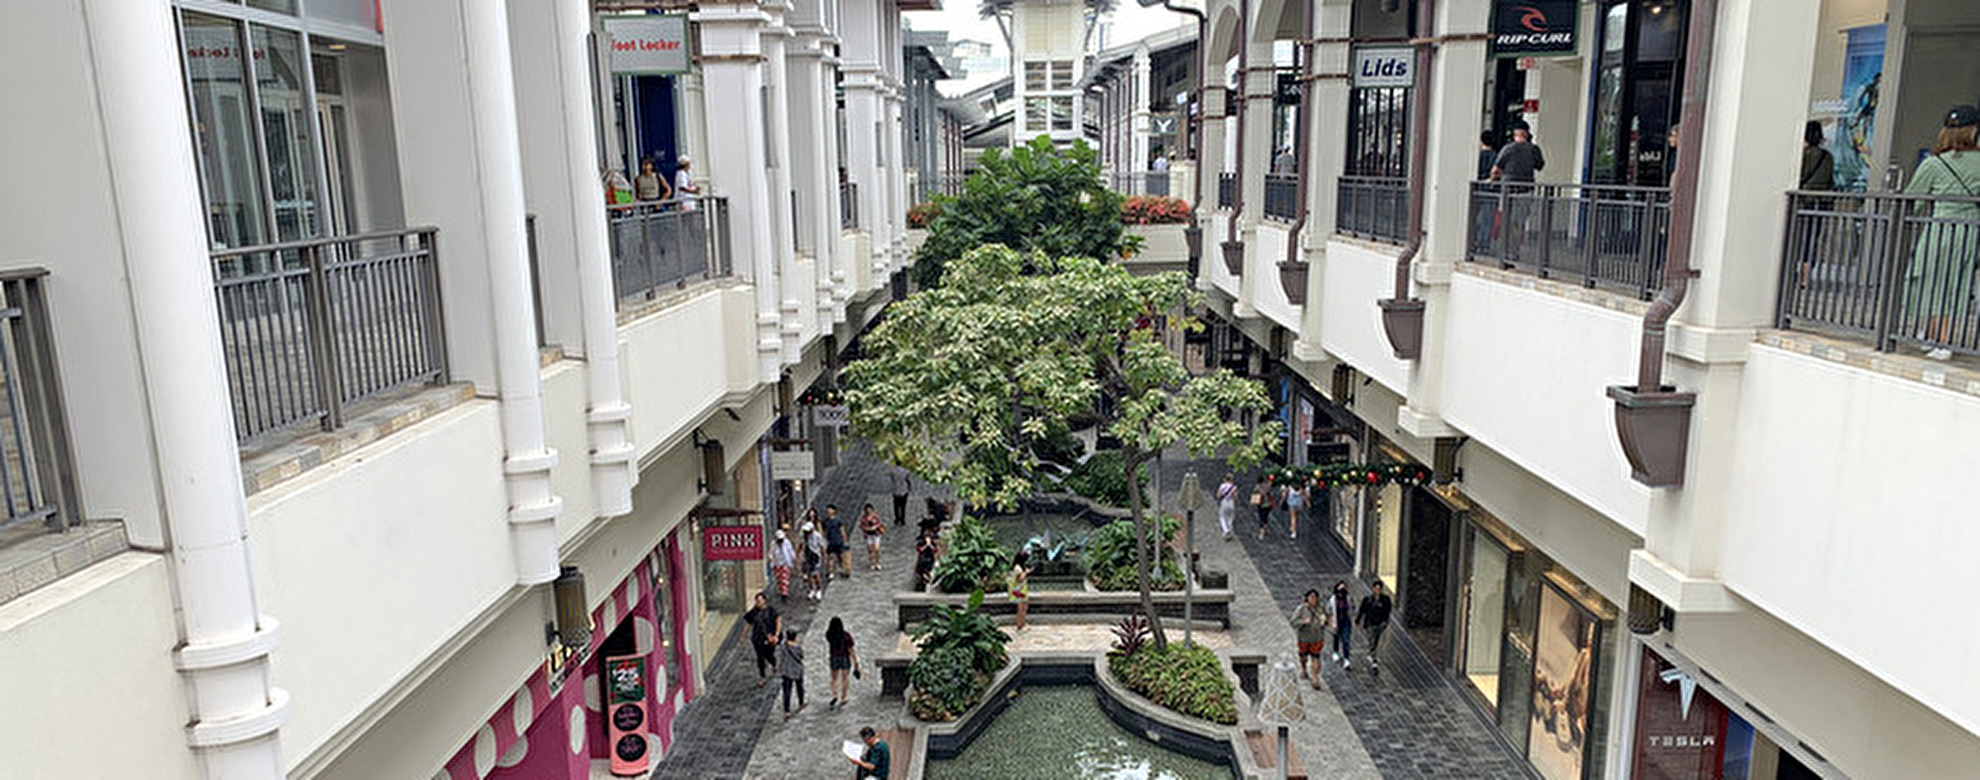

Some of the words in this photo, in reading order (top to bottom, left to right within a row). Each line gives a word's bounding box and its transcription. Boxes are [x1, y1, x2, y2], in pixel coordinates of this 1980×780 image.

[1496, 34, 1528, 45] RIP
[1528, 32, 1572, 45] CURL
[639, 39, 681, 52] Locker
[1361, 58, 1407, 77] Lids
[711, 533, 755, 548] PINK
[1649, 735, 1715, 747] TESLA
